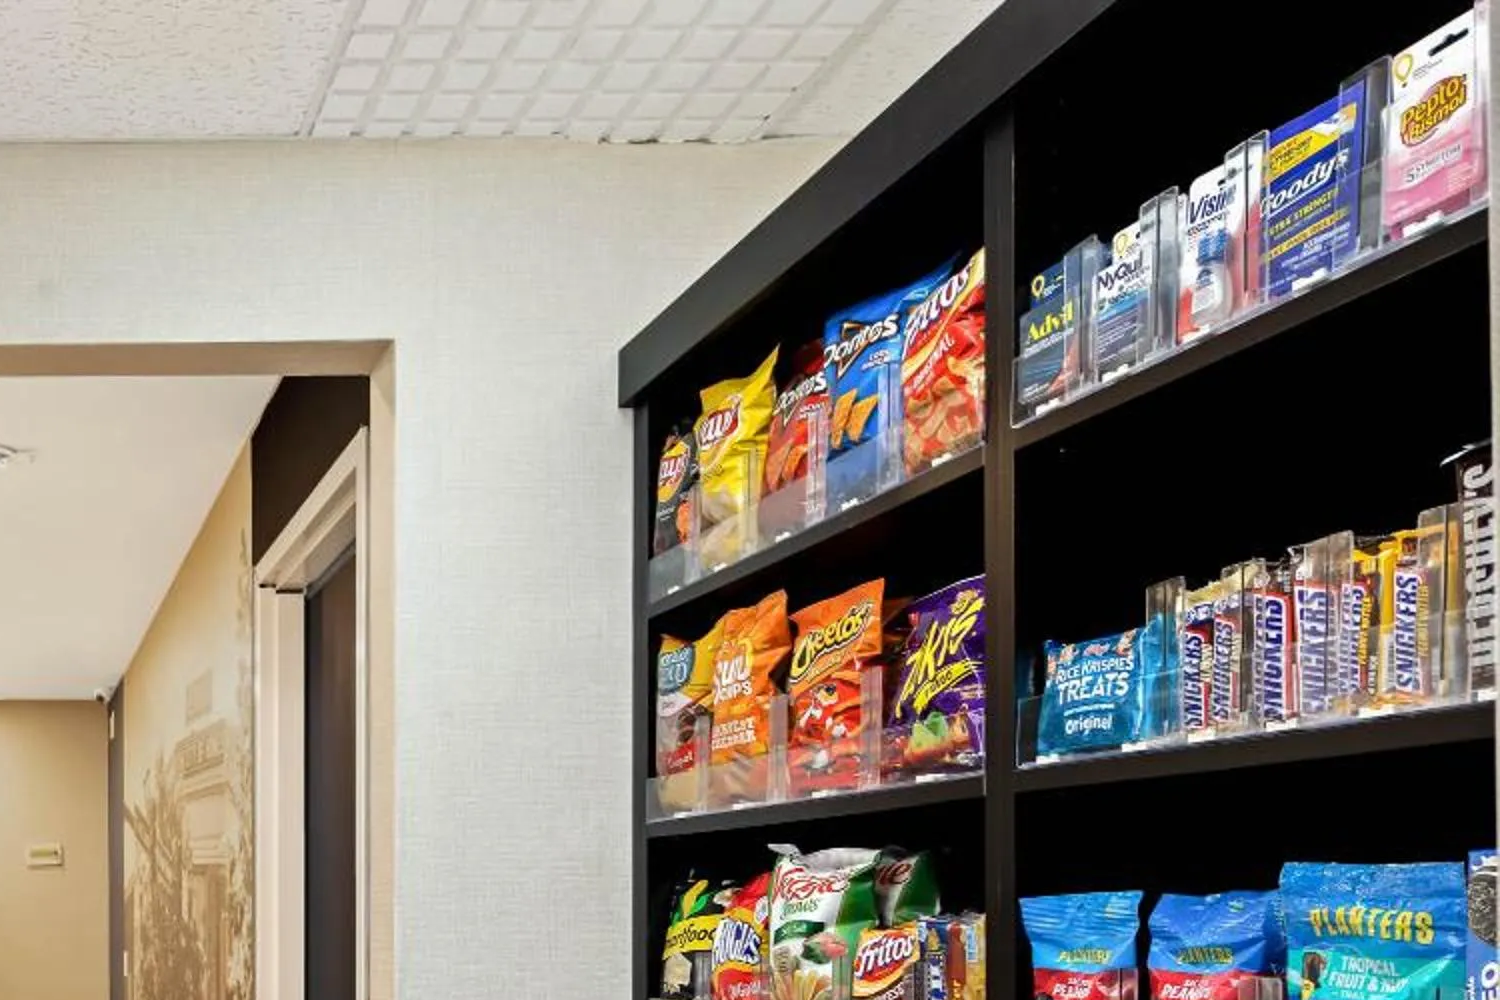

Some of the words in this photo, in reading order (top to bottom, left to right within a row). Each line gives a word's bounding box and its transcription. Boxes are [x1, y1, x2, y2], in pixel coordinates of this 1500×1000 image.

[1402, 78, 1461, 128] Pepto
[1028, 301, 1074, 344] Advil
[1396, 574, 1419, 691] SNICKERS
[1055, 664, 1081, 685] RICE
[1057, 671, 1130, 705] TREATS
[1309, 906, 1435, 945] PLANTERS
[854, 934, 915, 979] Fritos
[1341, 956, 1398, 977] TROPICAL
[1328, 971, 1364, 990] FRUIT
[1366, 974, 1378, 992] &
